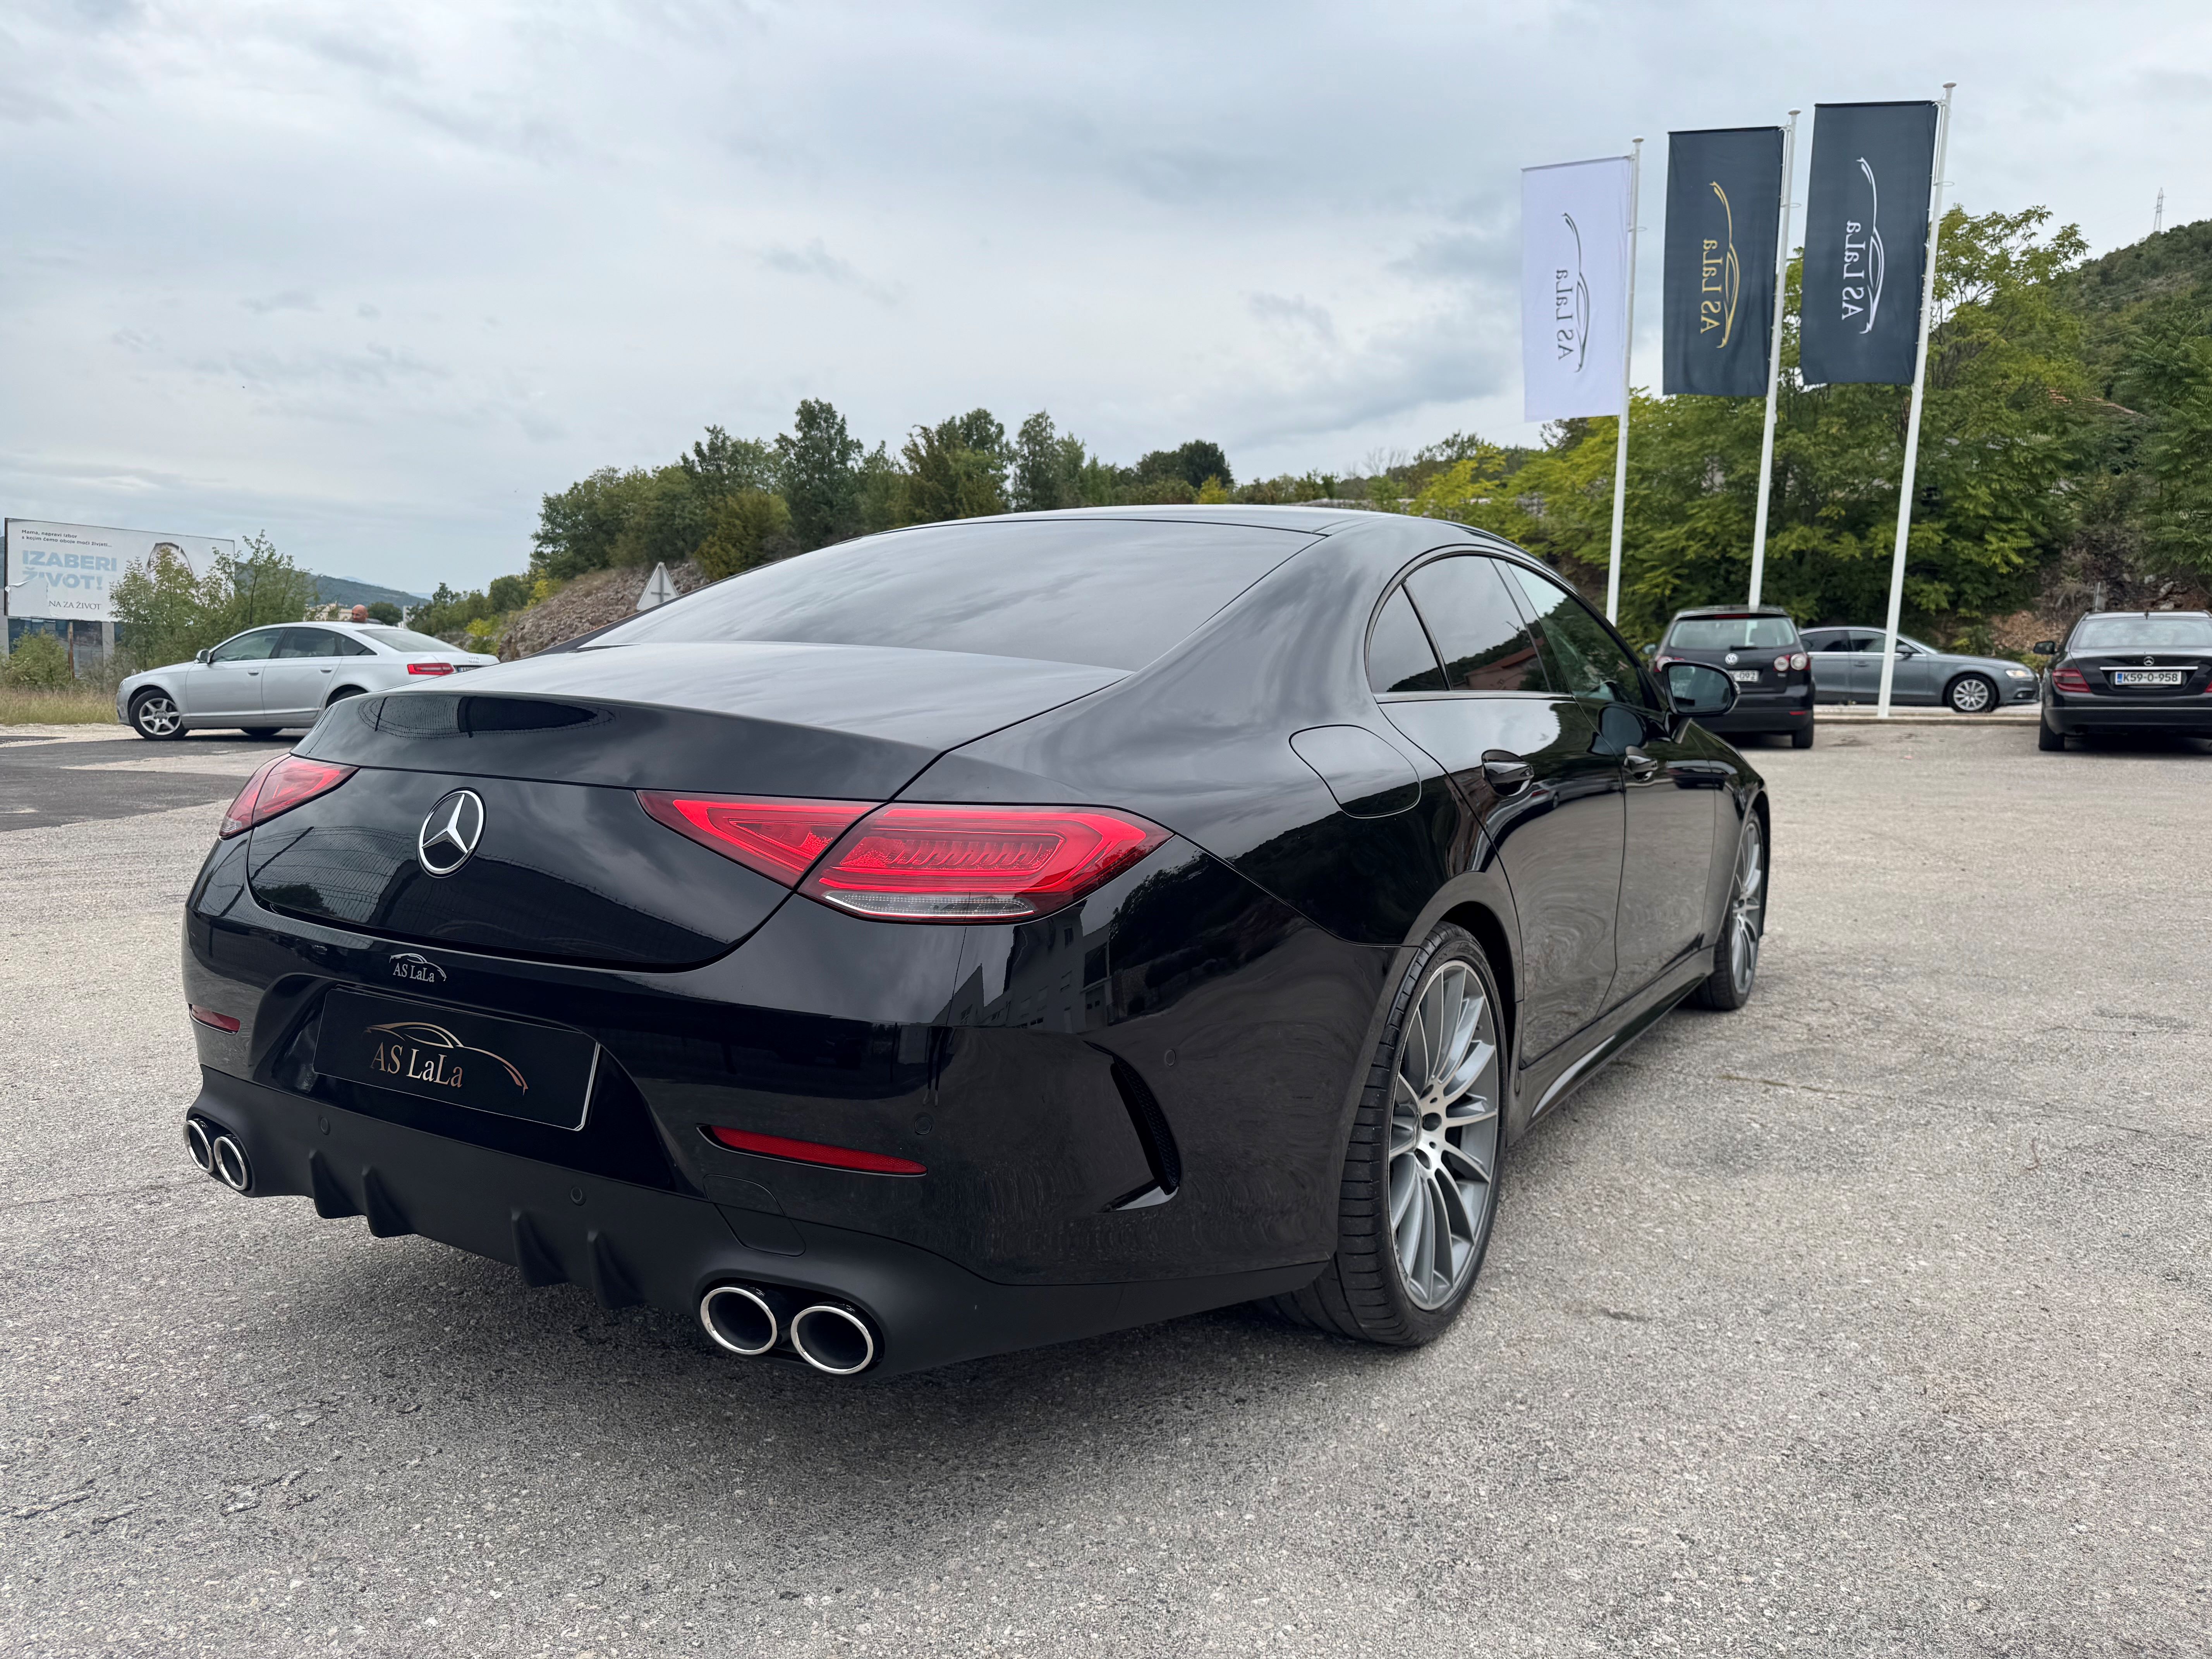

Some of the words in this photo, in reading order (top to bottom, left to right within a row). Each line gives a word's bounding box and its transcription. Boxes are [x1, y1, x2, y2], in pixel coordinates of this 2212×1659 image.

[22, 550, 117, 571] IZABERI
[76, 601, 102, 610] ŽIVOT
[2123, 673, 2178, 682] K59-0-958
[393, 962, 408, 977] AS
[409, 965, 434, 982] LaLa
[369, 1042, 403, 1074] AS
[406, 1048, 463, 1088] LaLa
